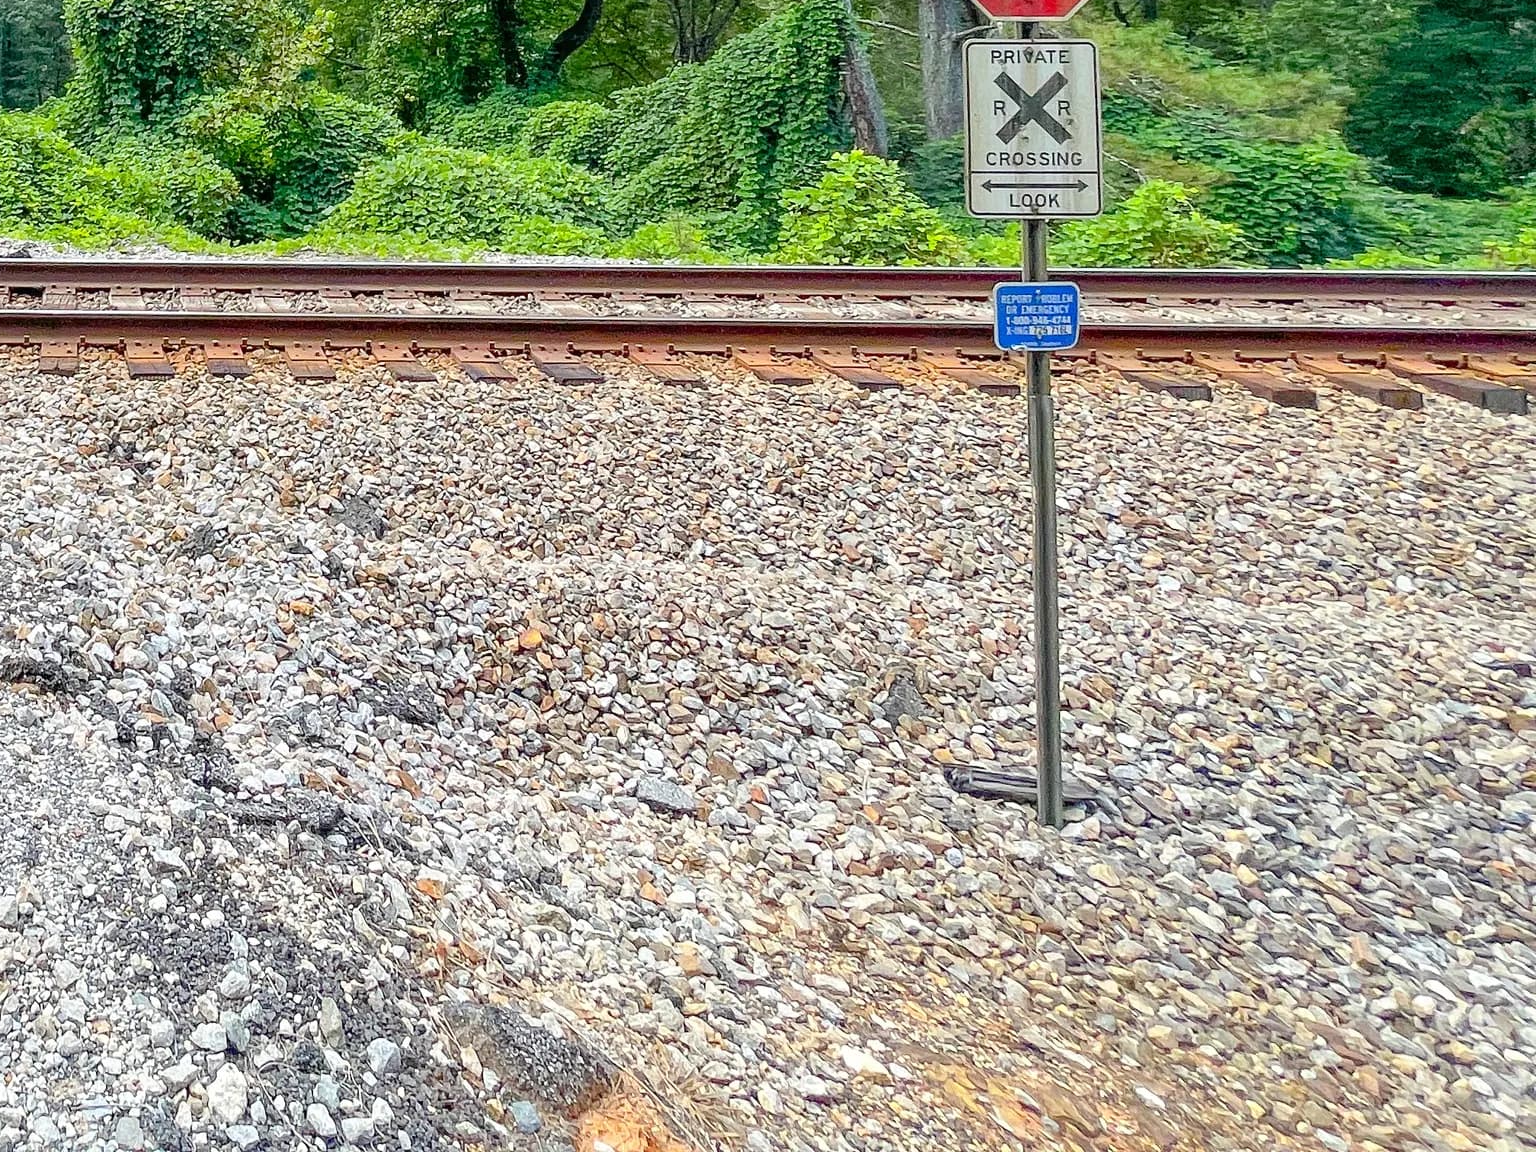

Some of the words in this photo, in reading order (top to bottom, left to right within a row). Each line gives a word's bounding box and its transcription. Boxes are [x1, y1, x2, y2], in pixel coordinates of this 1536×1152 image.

[991, 50, 1070, 64] PRIVATE
[993, 101, 1006, 116] R
[1058, 100, 1071, 115] R
[986, 151, 1083, 167] CROSSING
[1009, 193, 1061, 208] LOOK
[1001, 295, 1032, 304] REPORT
[1006, 305, 1017, 314] OR
[1021, 304, 1069, 314] EMERGENCY
